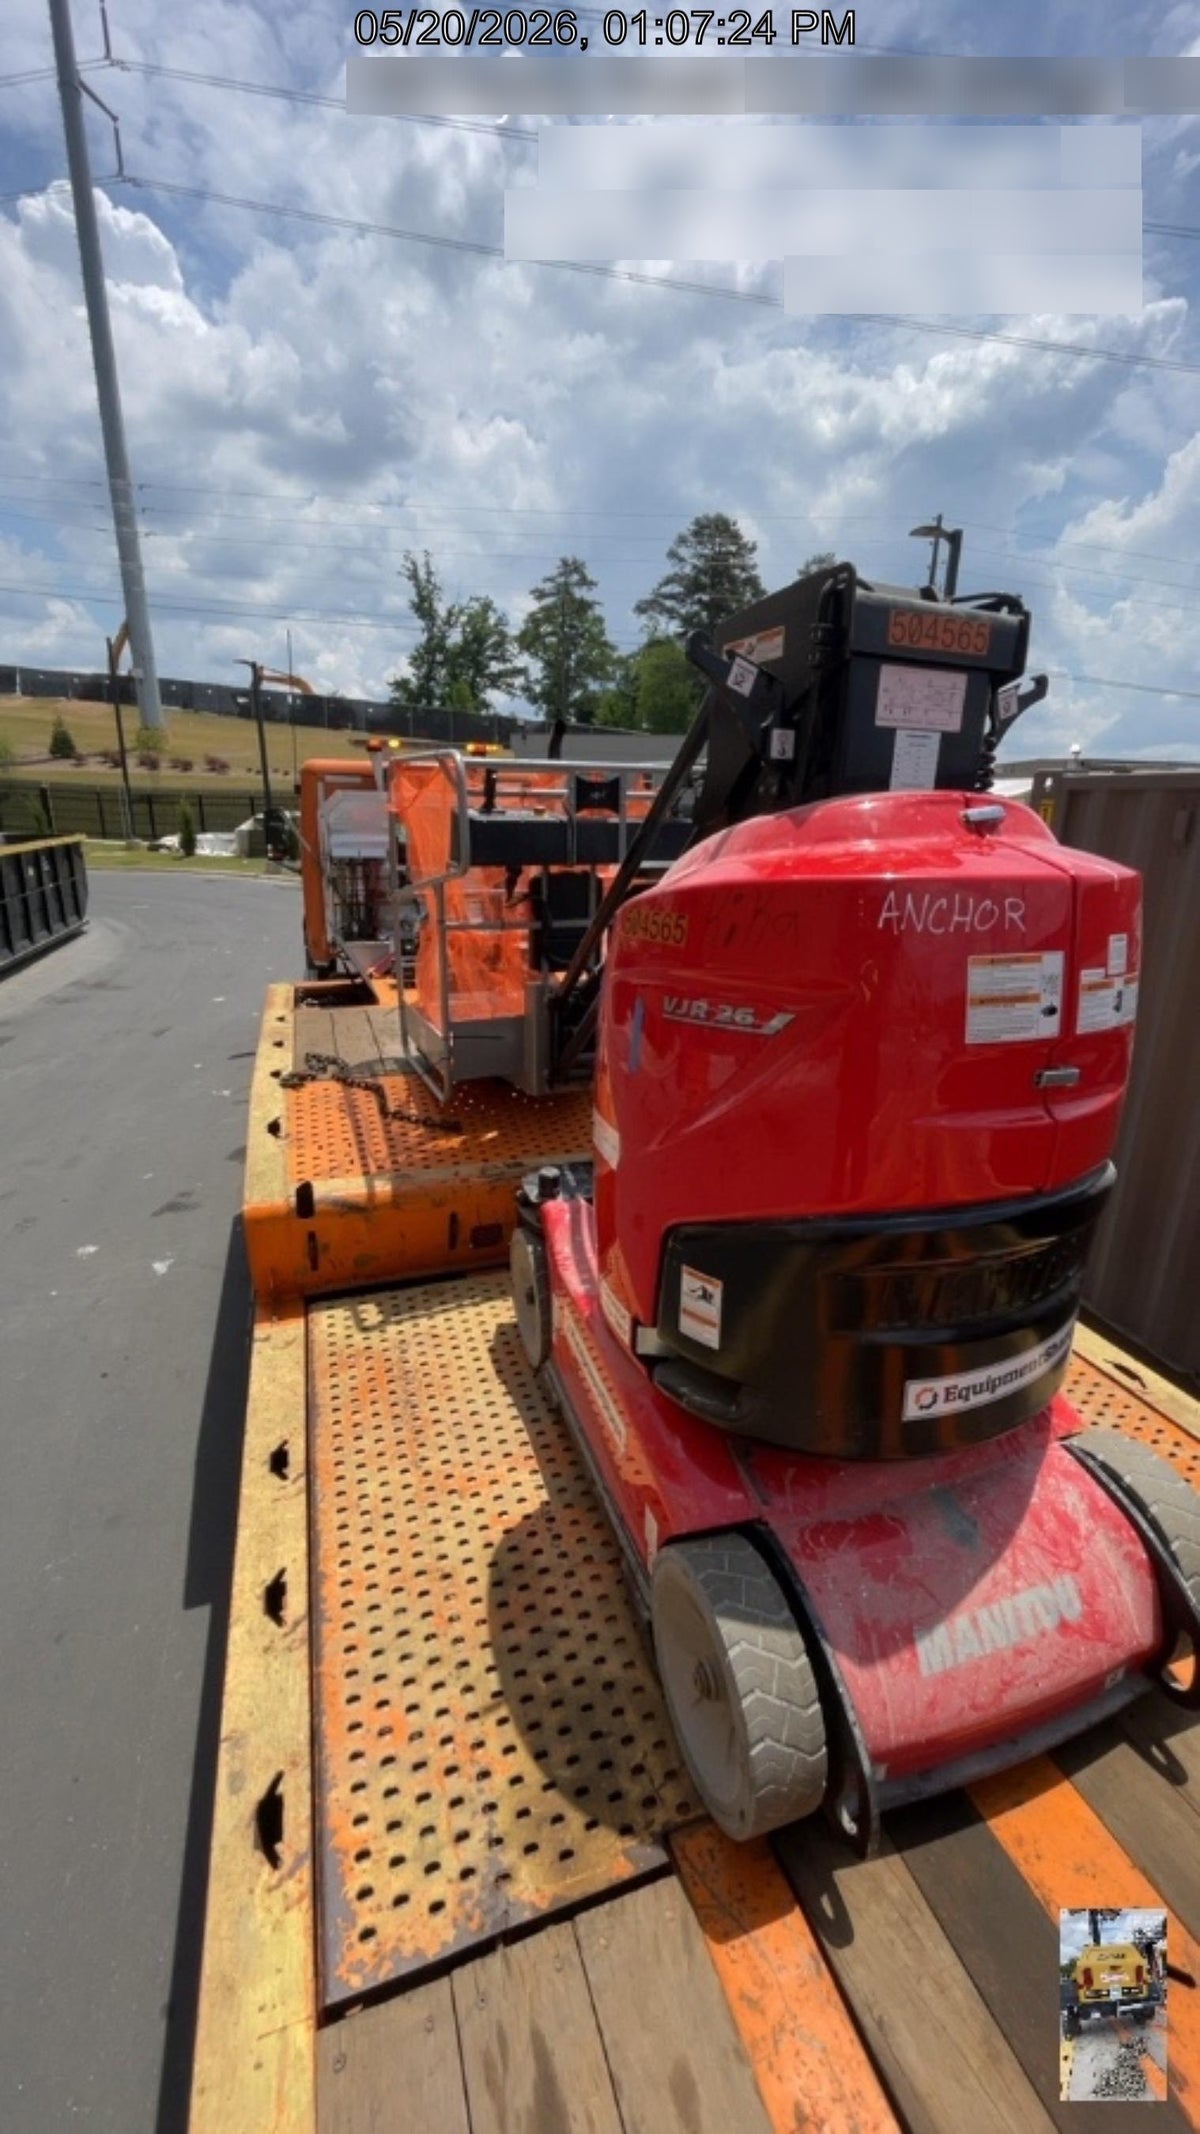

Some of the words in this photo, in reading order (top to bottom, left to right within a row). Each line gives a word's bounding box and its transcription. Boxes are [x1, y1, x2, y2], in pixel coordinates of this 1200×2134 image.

[891, 612, 988, 653] 504565
[877, 890, 1026, 935] ANCHOR
[662, 996, 708, 1019] VJR
[715, 1004, 756, 1026] 26
[914, 1575, 1083, 1679] MANITOU
